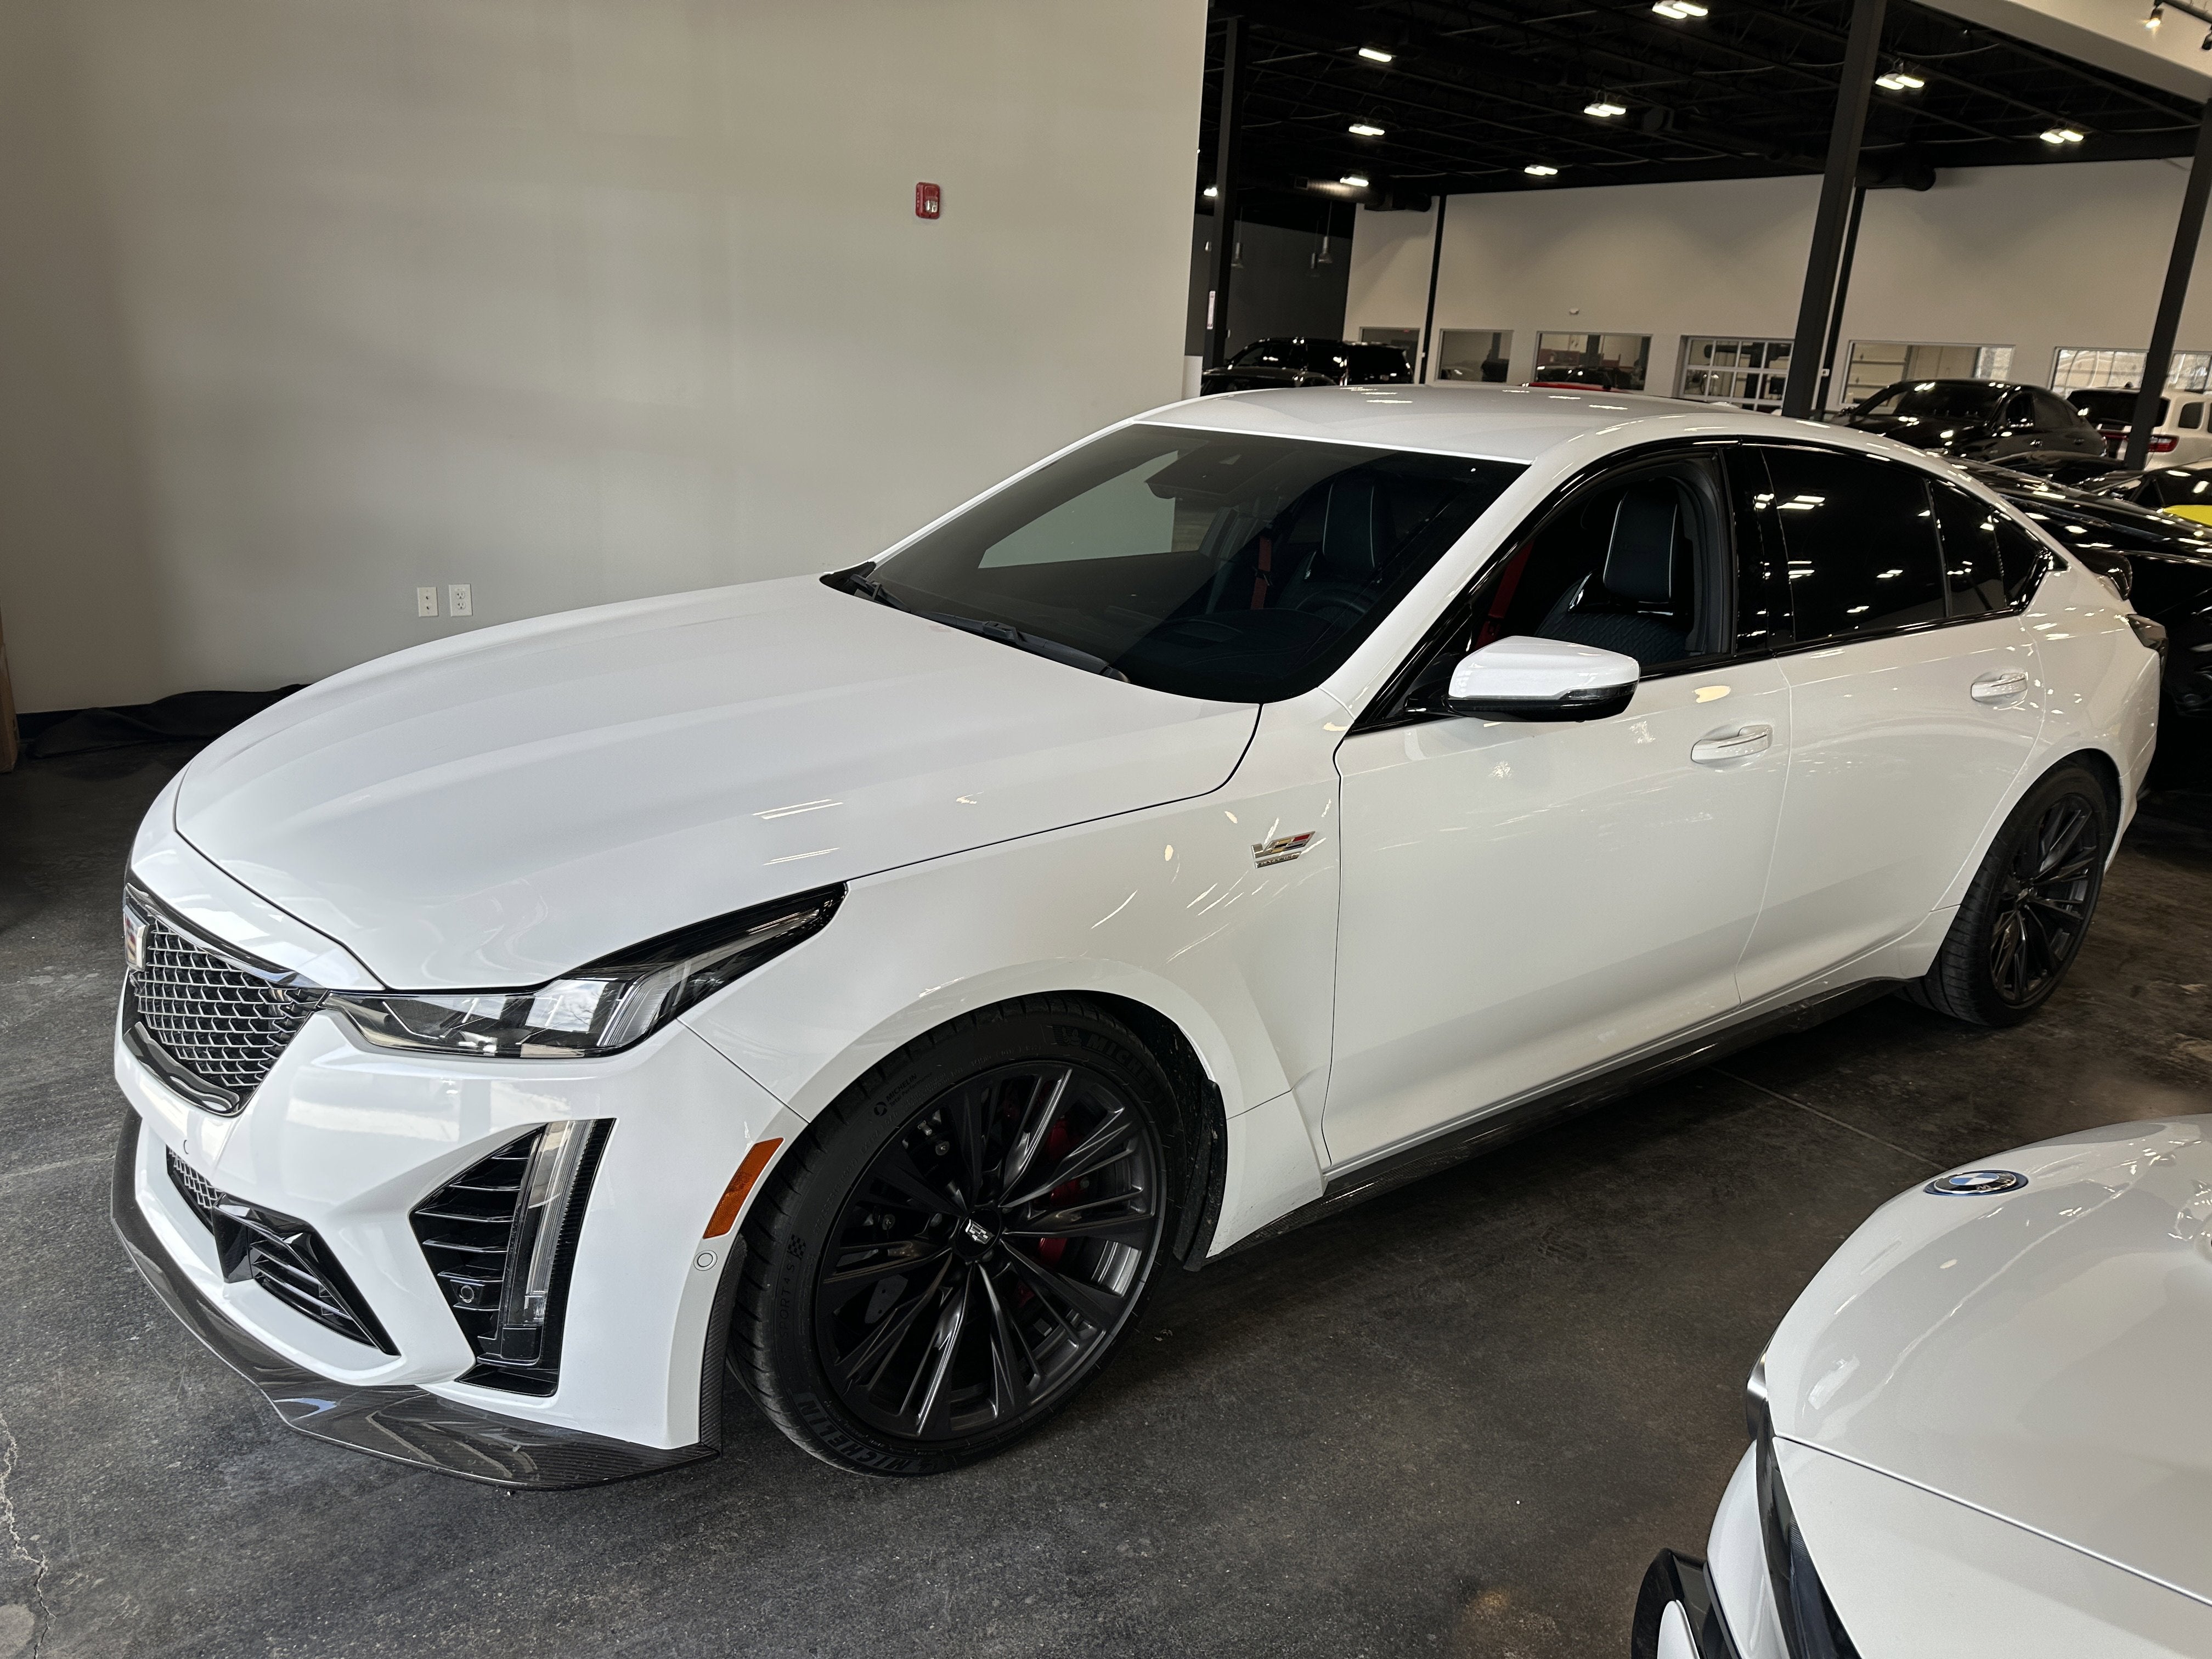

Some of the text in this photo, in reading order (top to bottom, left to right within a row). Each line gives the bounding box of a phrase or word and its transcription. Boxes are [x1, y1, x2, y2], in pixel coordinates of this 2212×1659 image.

[1257, 854, 1298, 867] BLACKWING
[885, 1073, 918, 1102] MICHELIN
[889, 1095, 901, 1107] Total
[901, 1071, 933, 1096] Performance
[786, 1263, 795, 1272] S
[797, 1400, 912, 1471] MICHELIN
